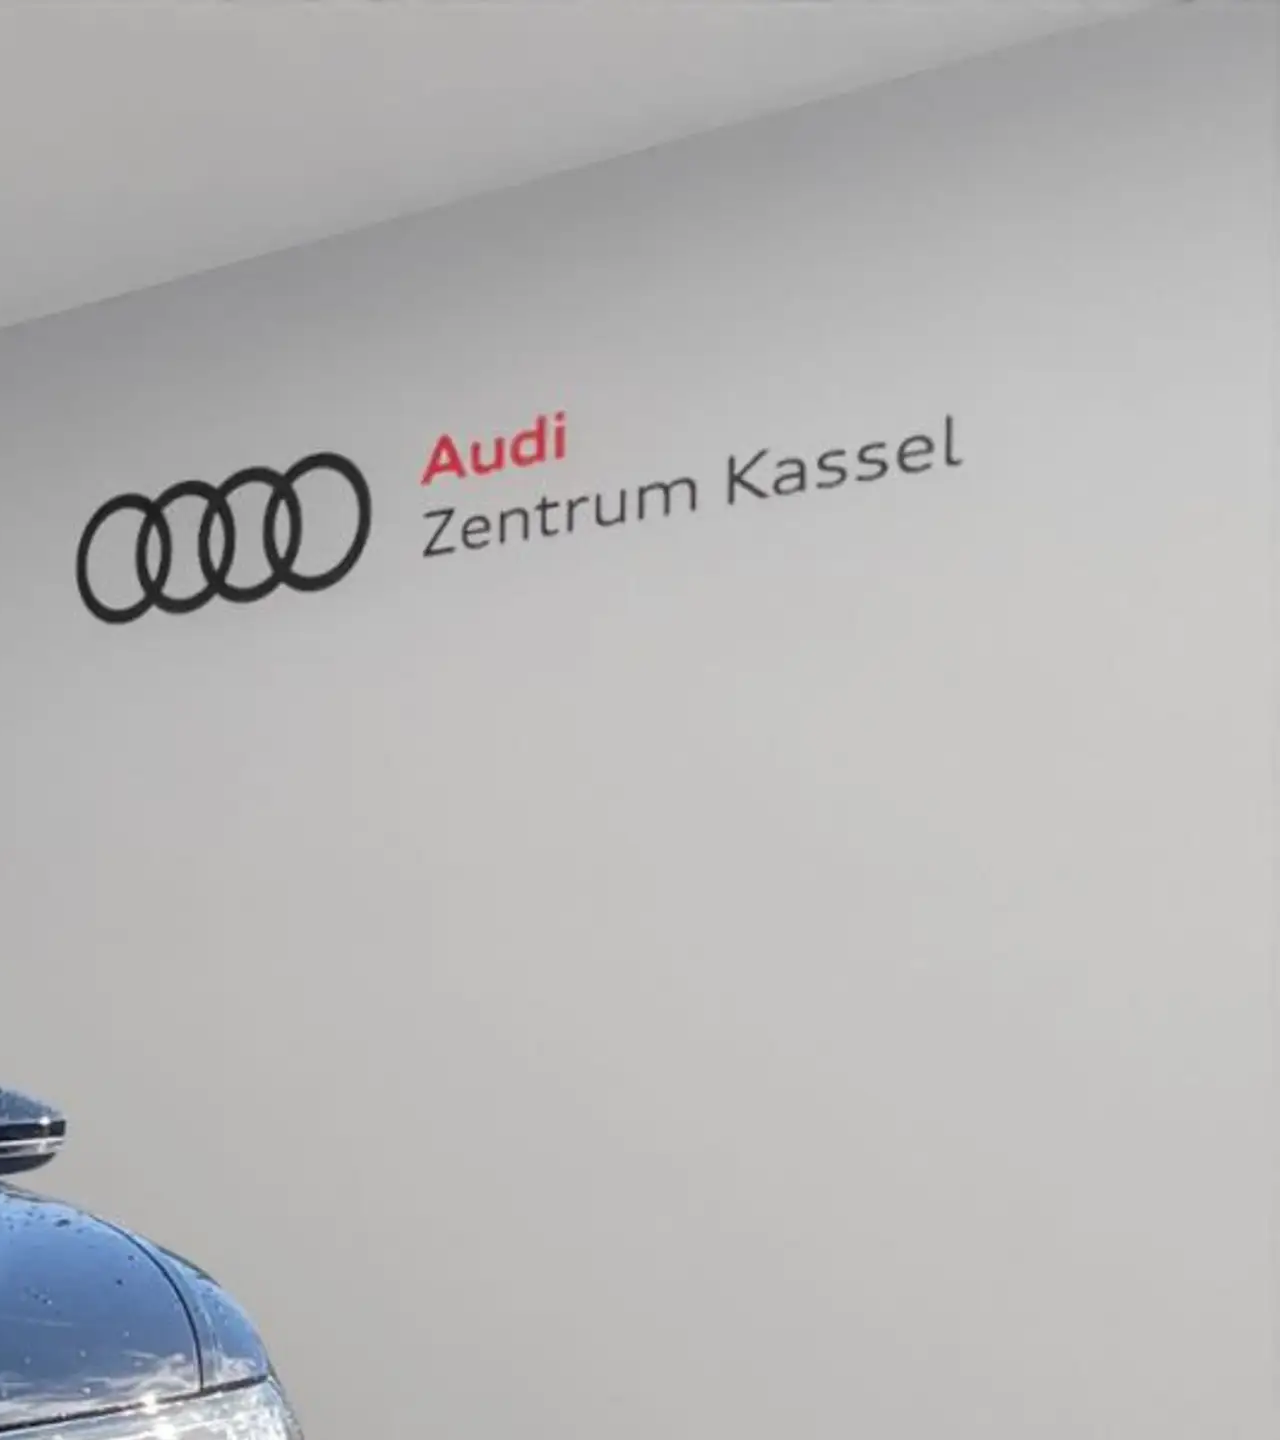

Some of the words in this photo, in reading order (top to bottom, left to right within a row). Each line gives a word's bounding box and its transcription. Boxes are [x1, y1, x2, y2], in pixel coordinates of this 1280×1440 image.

[421, 411, 566, 484] Audi
[422, 476, 697, 558] Zentrum
[727, 414, 963, 506] Kassel
